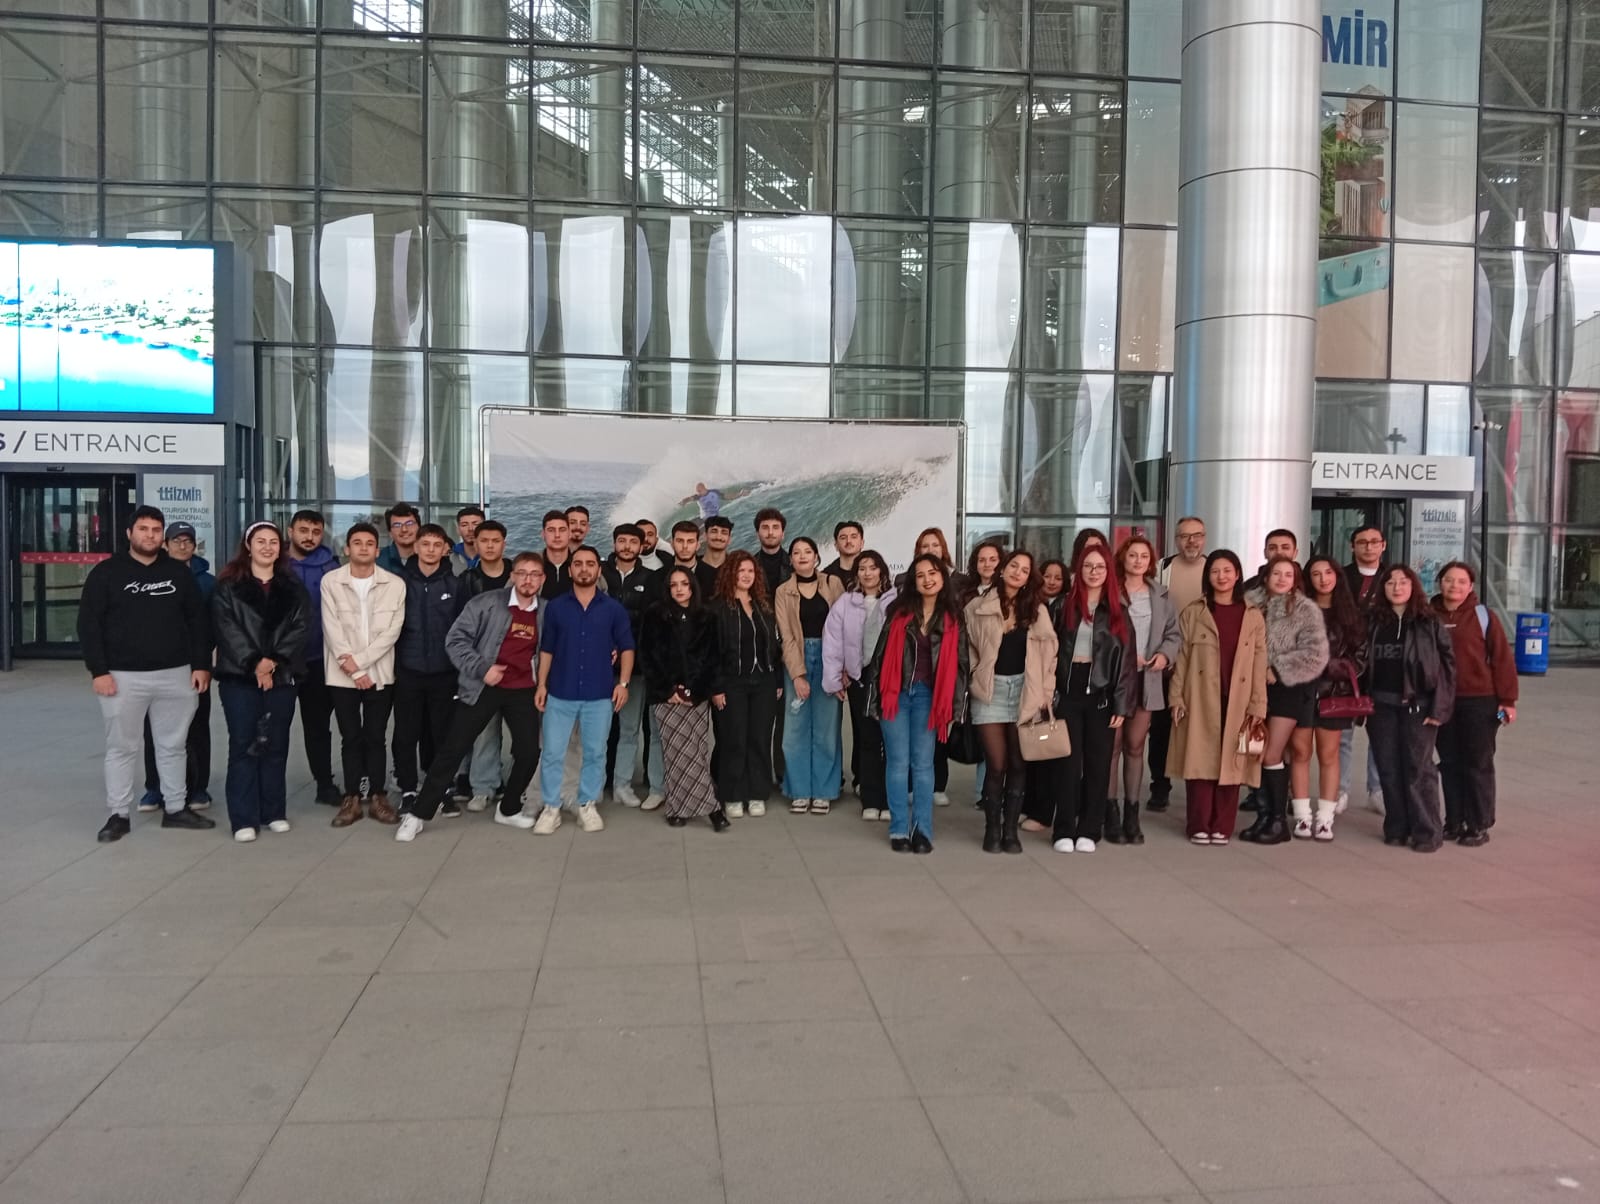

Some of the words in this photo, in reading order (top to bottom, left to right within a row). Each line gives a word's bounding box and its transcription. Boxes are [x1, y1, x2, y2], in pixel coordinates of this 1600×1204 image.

[1322, 9, 1388, 68] MİR
[34, 433, 177, 453] ENTRANCE
[1323, 462, 1437, 481] ENTRANCE
